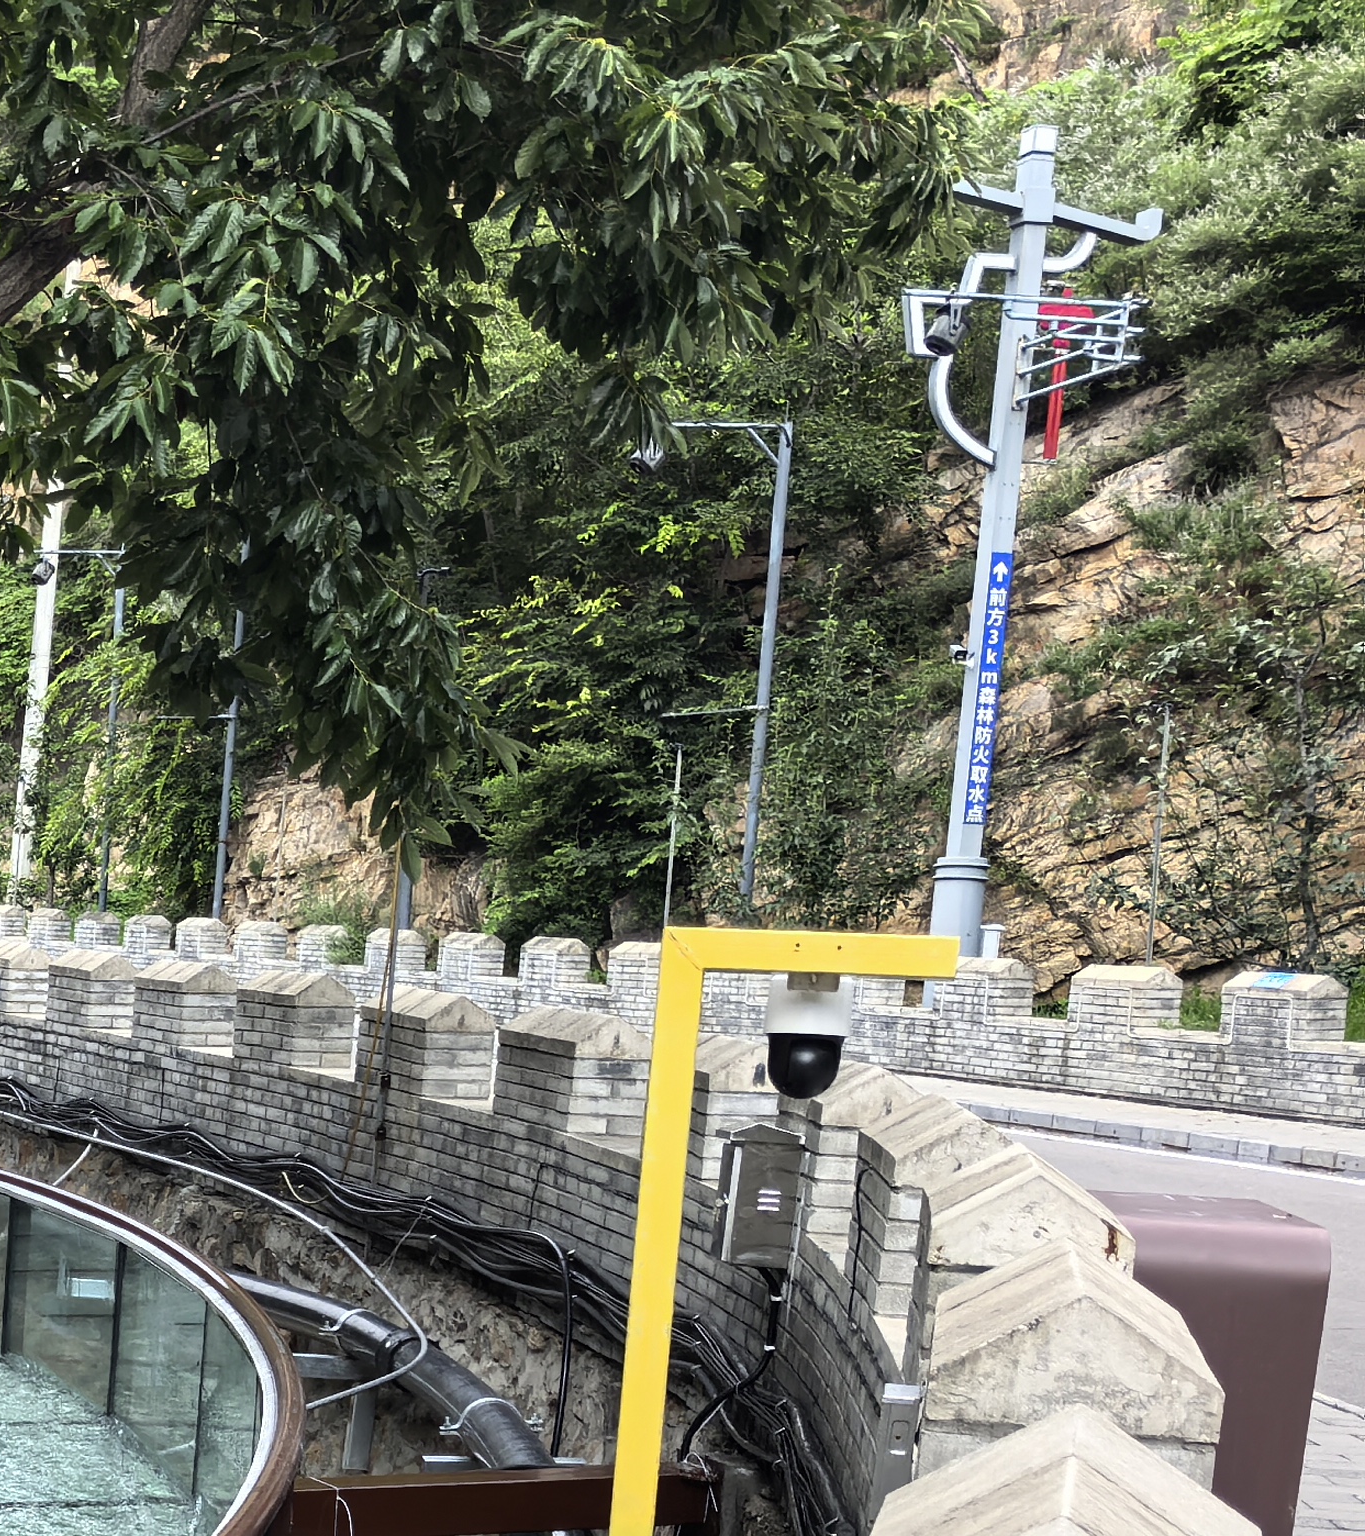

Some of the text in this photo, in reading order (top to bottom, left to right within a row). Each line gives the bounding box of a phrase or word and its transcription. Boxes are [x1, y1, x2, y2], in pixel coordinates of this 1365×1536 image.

[965, 587, 1006, 822] 前方3km森林防火取水点
